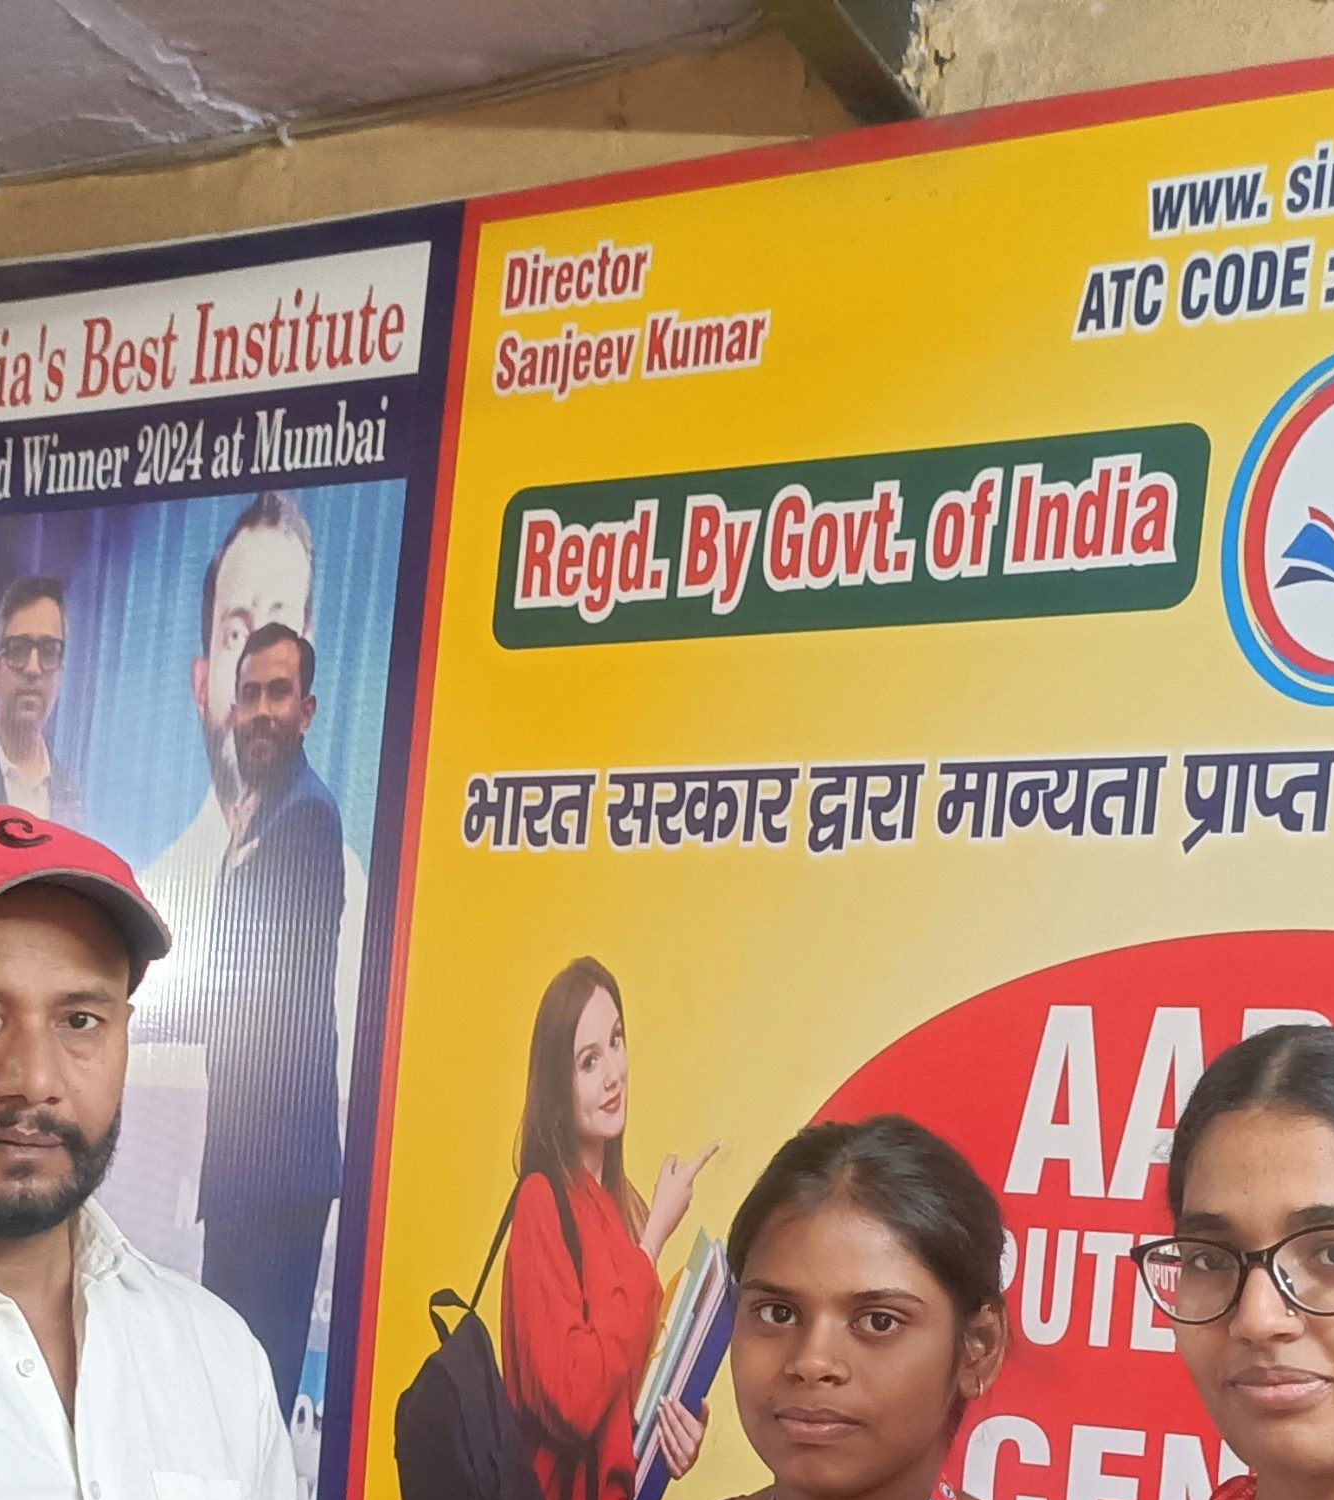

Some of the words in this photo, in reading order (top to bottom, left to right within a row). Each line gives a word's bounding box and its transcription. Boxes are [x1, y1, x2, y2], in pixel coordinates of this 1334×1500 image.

[1150, 172, 1267, 231] www.
[504, 247, 649, 311] Director
[1078, 266, 1164, 332] ATC
[1183, 249, 1309, 322] CODE
[77, 313, 178, 399] Best
[189, 284, 405, 384] Institute
[496, 328, 633, 395] Sanjeev
[646, 314, 766, 374] Kumar
[23, 433, 129, 496] Winner
[134, 419, 205, 487] 2024
[212, 418, 243, 477] at
[250, 397, 388, 476] Mumbai
[521, 511, 663, 612] Regd.
[685, 503, 755, 605] By
[769, 488, 908, 581] Govt.
[932, 475, 996, 570] of
[1011, 462, 1168, 564] India
[466, 774, 596, 847] भारत
[607, 766, 799, 845] सरकार
[809, 762, 924, 851] द्वारा
[939, 755, 1168, 837] मान्यता
